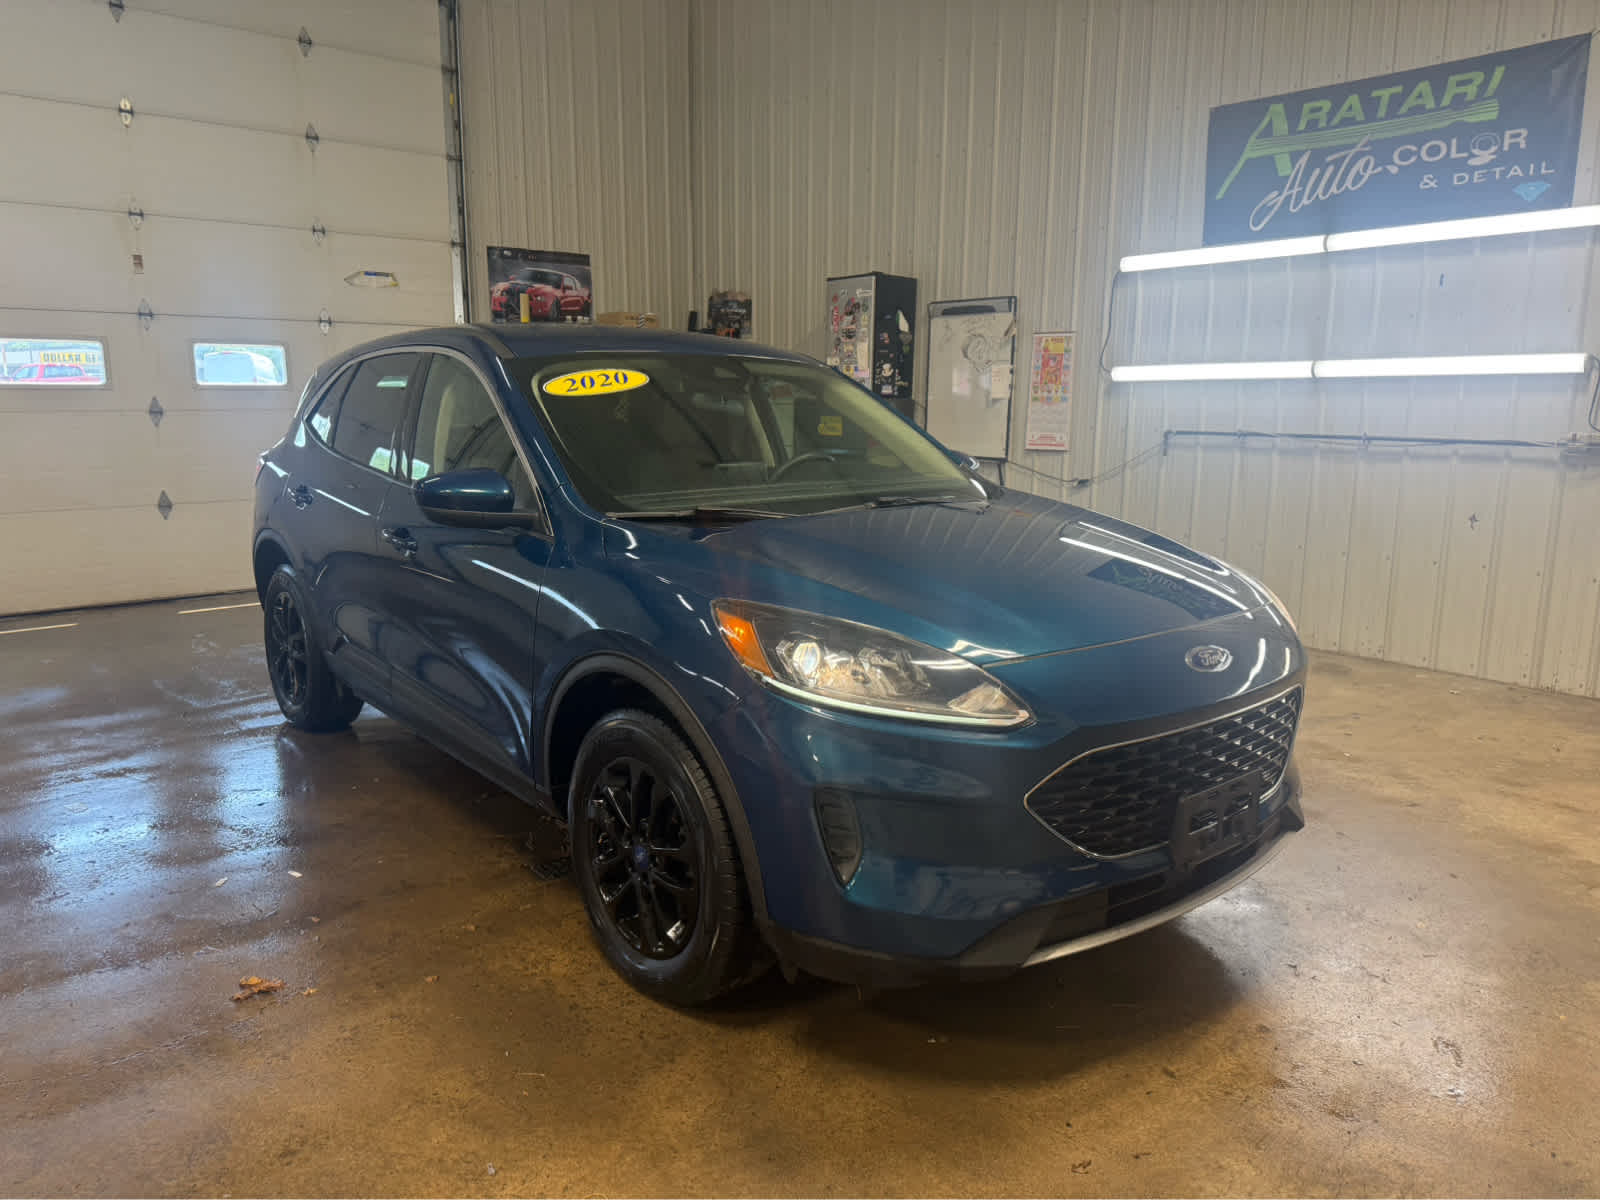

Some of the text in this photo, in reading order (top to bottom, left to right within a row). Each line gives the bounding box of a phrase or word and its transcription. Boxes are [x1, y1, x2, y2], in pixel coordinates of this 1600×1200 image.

[1216, 65, 1507, 200] ARATARI
[1419, 160, 1556, 190] & DETAIL
[563, 370, 629, 393] 2020
